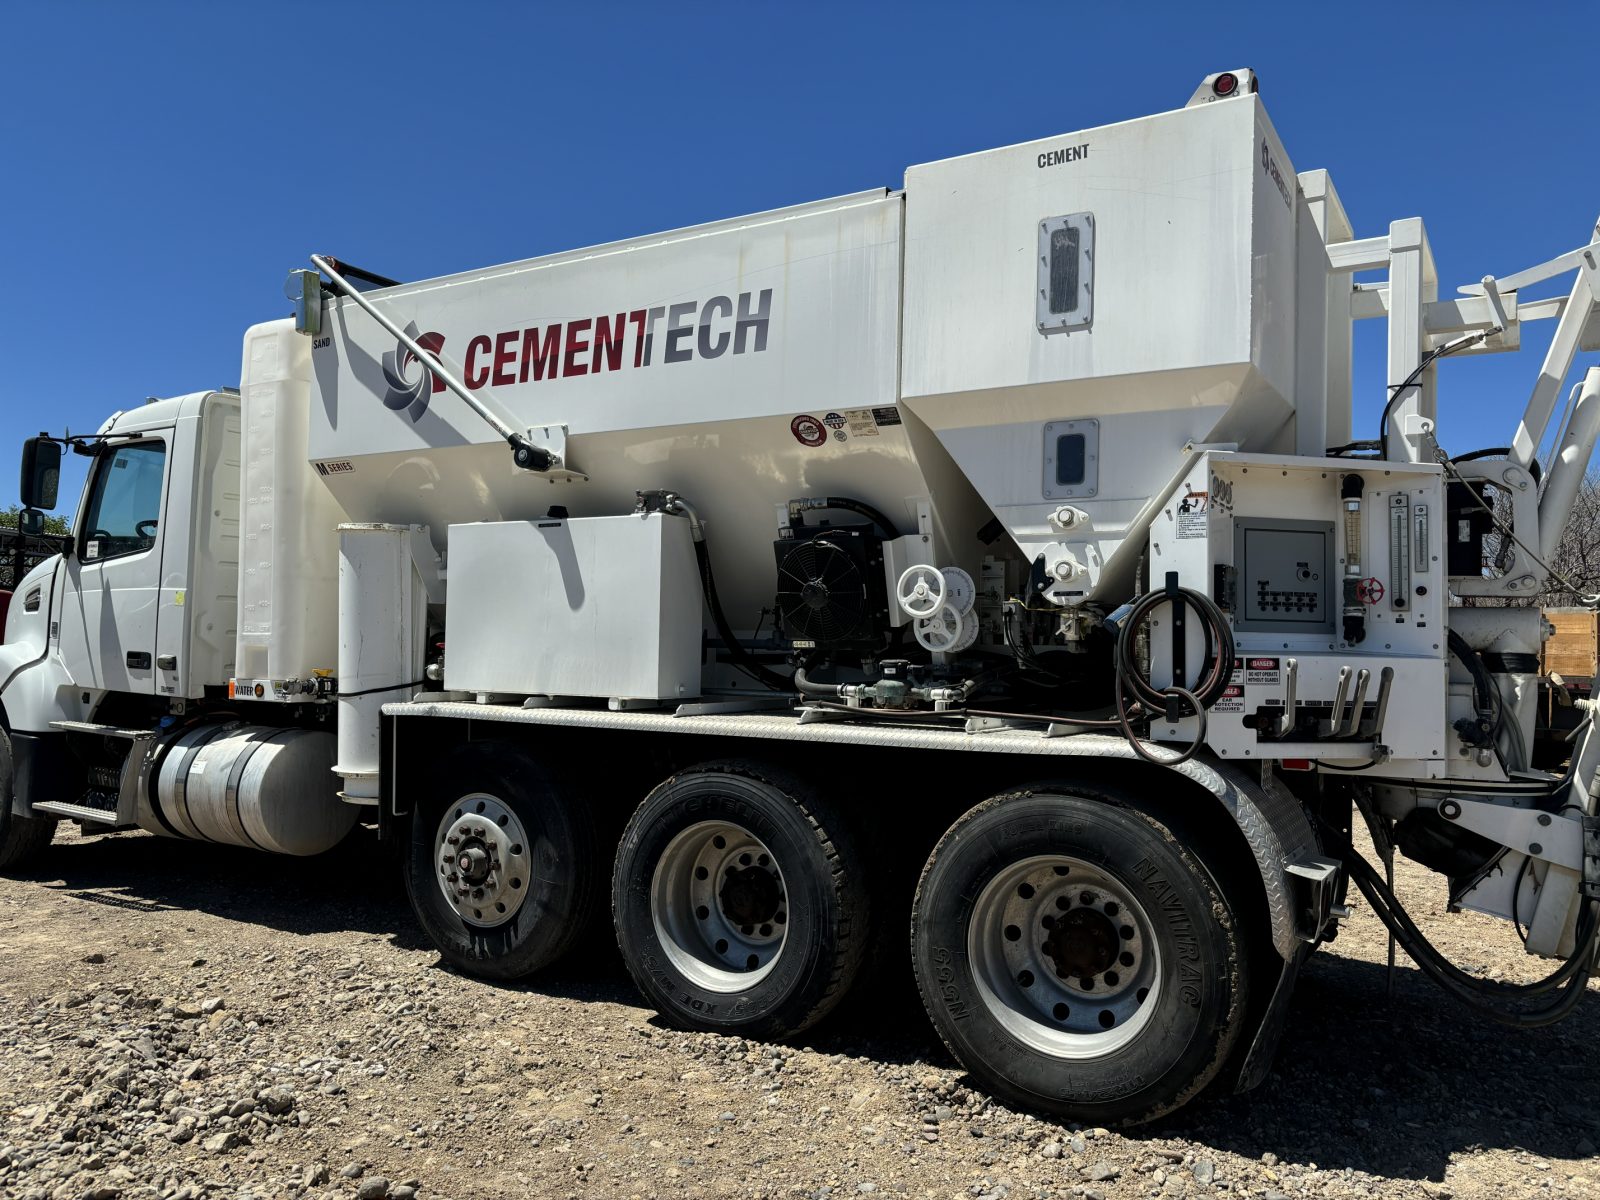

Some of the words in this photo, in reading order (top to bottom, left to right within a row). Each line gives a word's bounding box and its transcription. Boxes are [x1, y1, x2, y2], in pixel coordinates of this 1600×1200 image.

[1037, 143, 1090, 168] CEMENT
[313, 336, 331, 350] SAND
[463, 288, 773, 391] CEMENTECH
[315, 462, 330, 476] M
[327, 461, 353, 472] SERIES
[235, 685, 253, 696] WATER
[1131, 857, 1202, 1008] NAVITRAC
[931, 945, 970, 1021] N555
